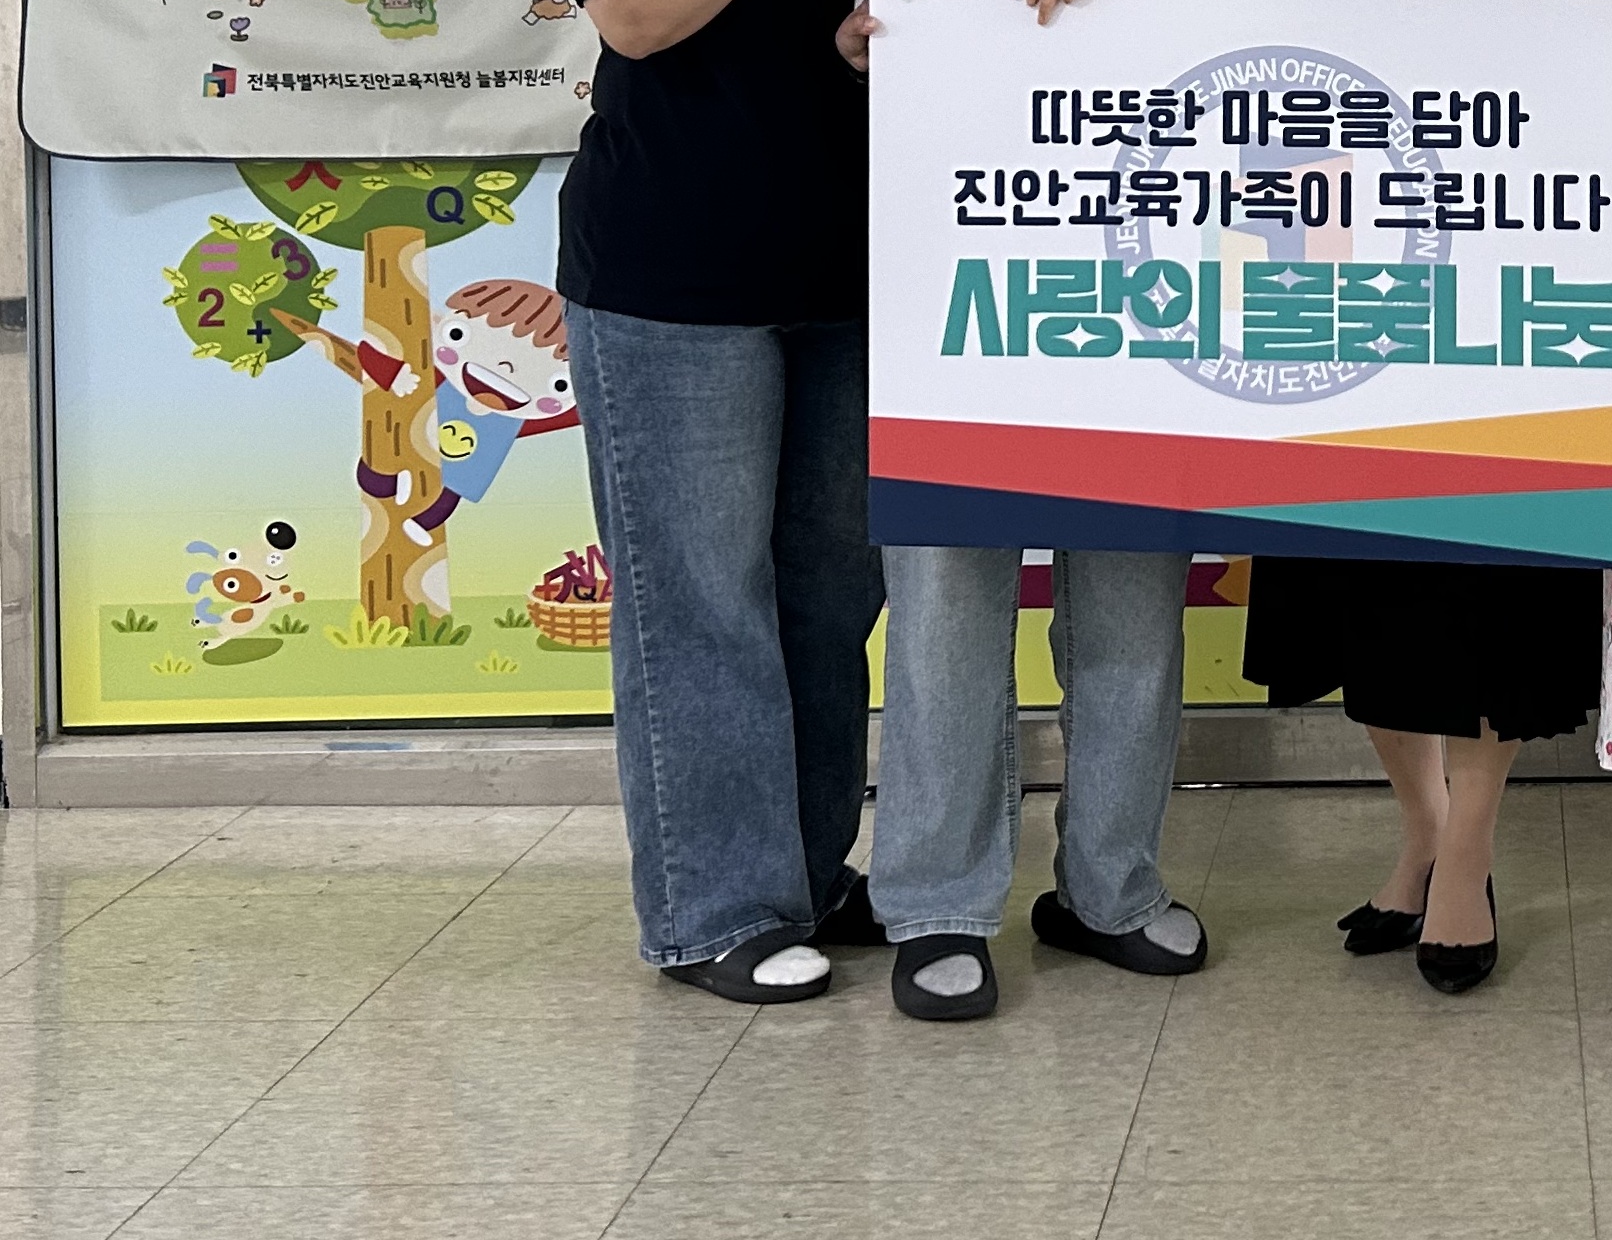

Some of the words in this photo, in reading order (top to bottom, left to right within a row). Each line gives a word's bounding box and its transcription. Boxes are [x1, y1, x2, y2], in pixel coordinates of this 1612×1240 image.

[247, 69, 471, 93] 전북특별자치도진안교육지원청
[476, 67, 566, 89] 늘봄지원센터
[1210, 57, 1278, 97] JINAN
[1031, 88, 1205, 148] 따뜻한
[1221, 89, 1393, 149] 마음을
[1411, 89, 1530, 150] 담아
[426, 185, 465, 225] Q
[952, 168, 1352, 229] 진안교육가족이
[1374, 170, 1611, 233] 드립니다
[271, 238, 311, 282] 3
[197, 288, 226, 328] 2
[940, 257, 1222, 360] 사랑의
